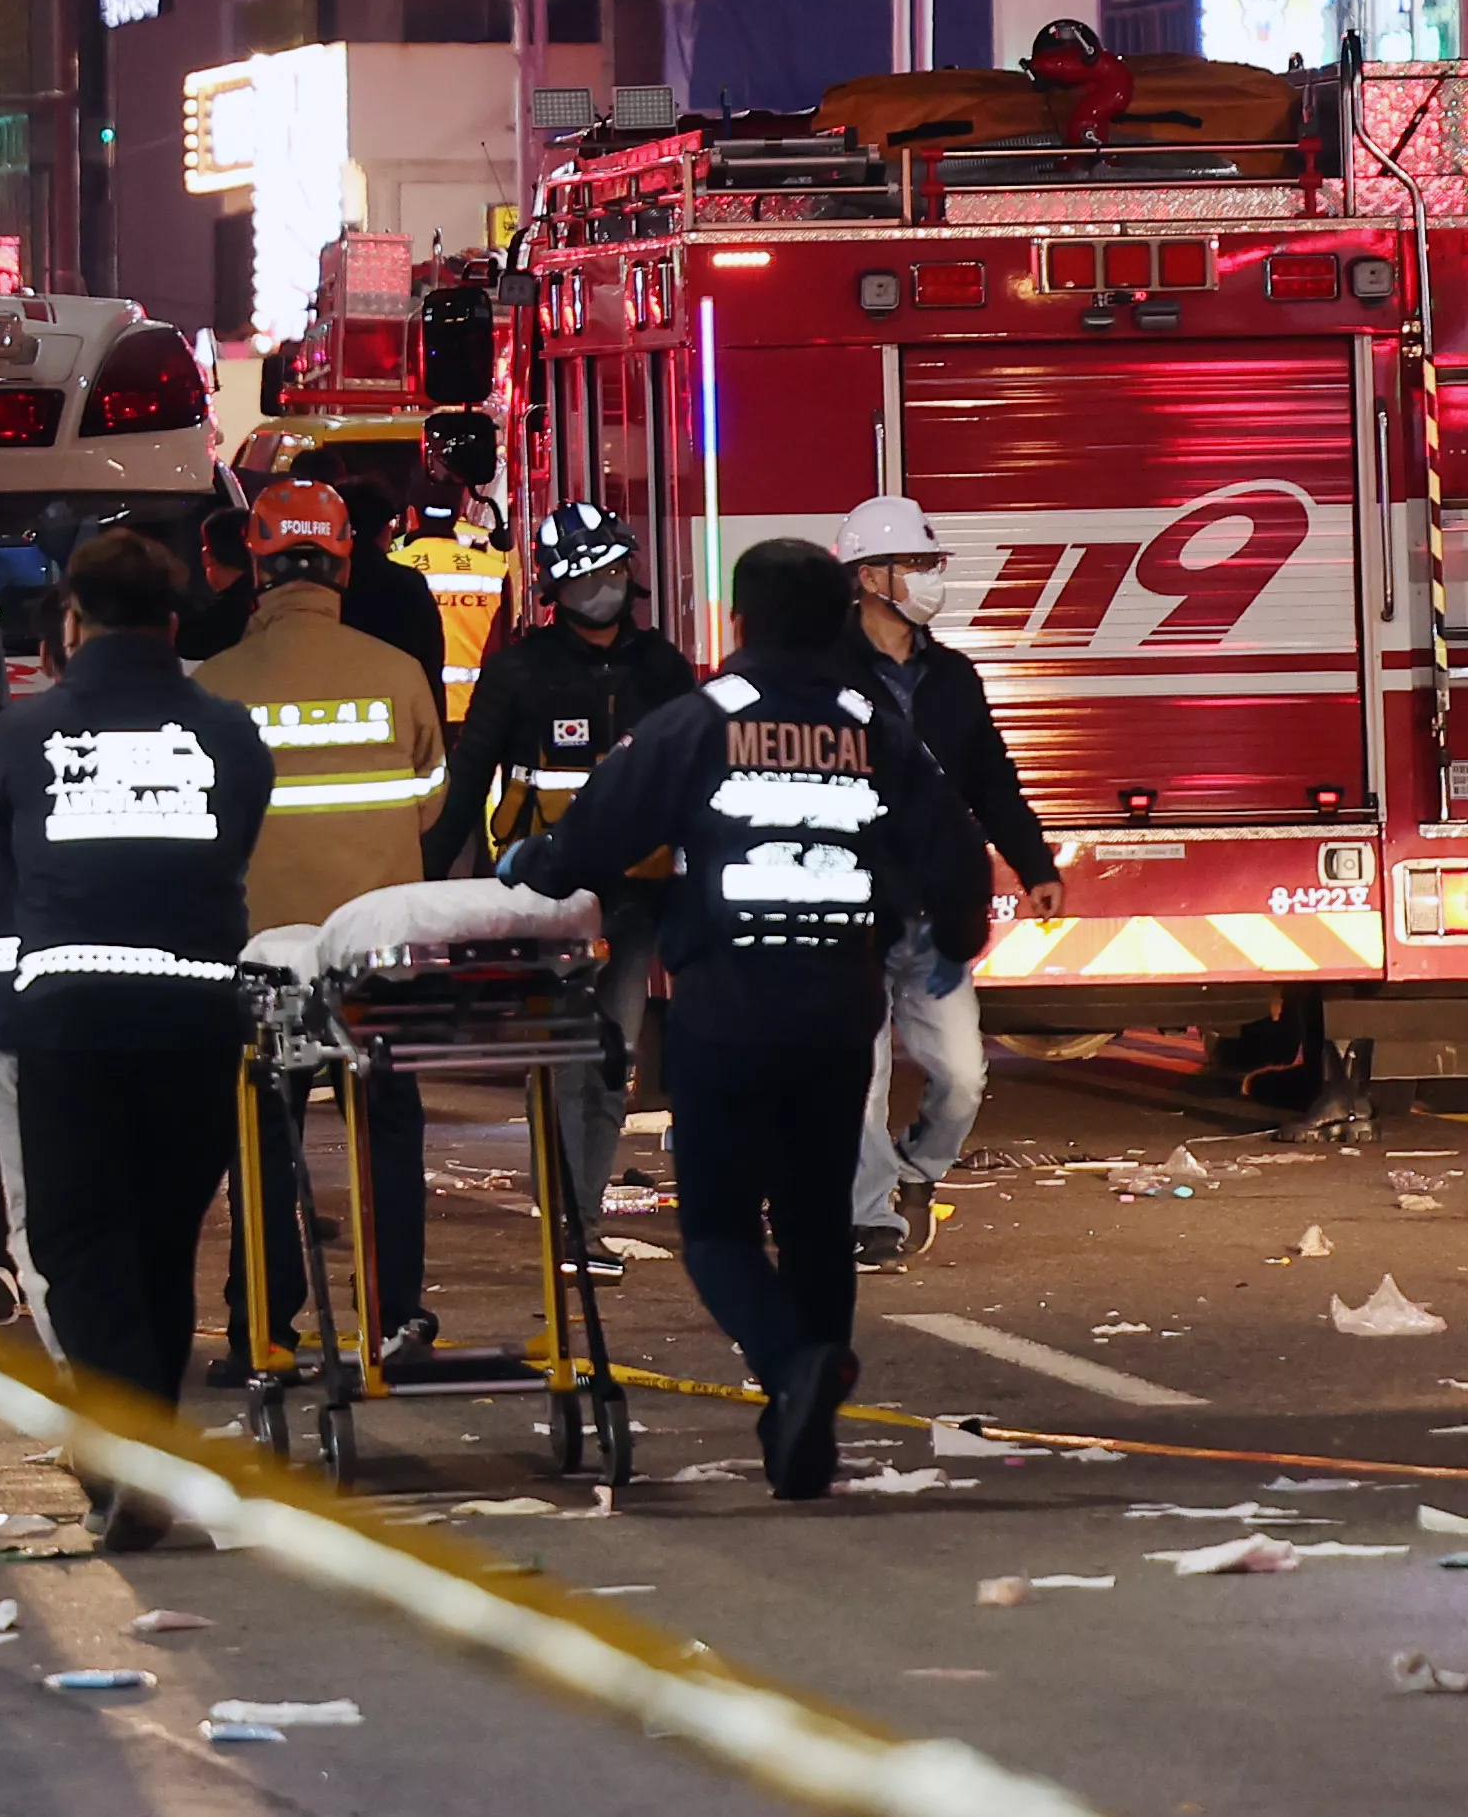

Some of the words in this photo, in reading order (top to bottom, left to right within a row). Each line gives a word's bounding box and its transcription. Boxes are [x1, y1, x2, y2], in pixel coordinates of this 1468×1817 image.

[969, 480, 1323, 648] 119
[438, 593, 489, 607] LICE
[727, 720, 874, 774] MEDICAL
[991, 894, 1020, 922] 방
[1267, 886, 1373, 915] 용산22호
